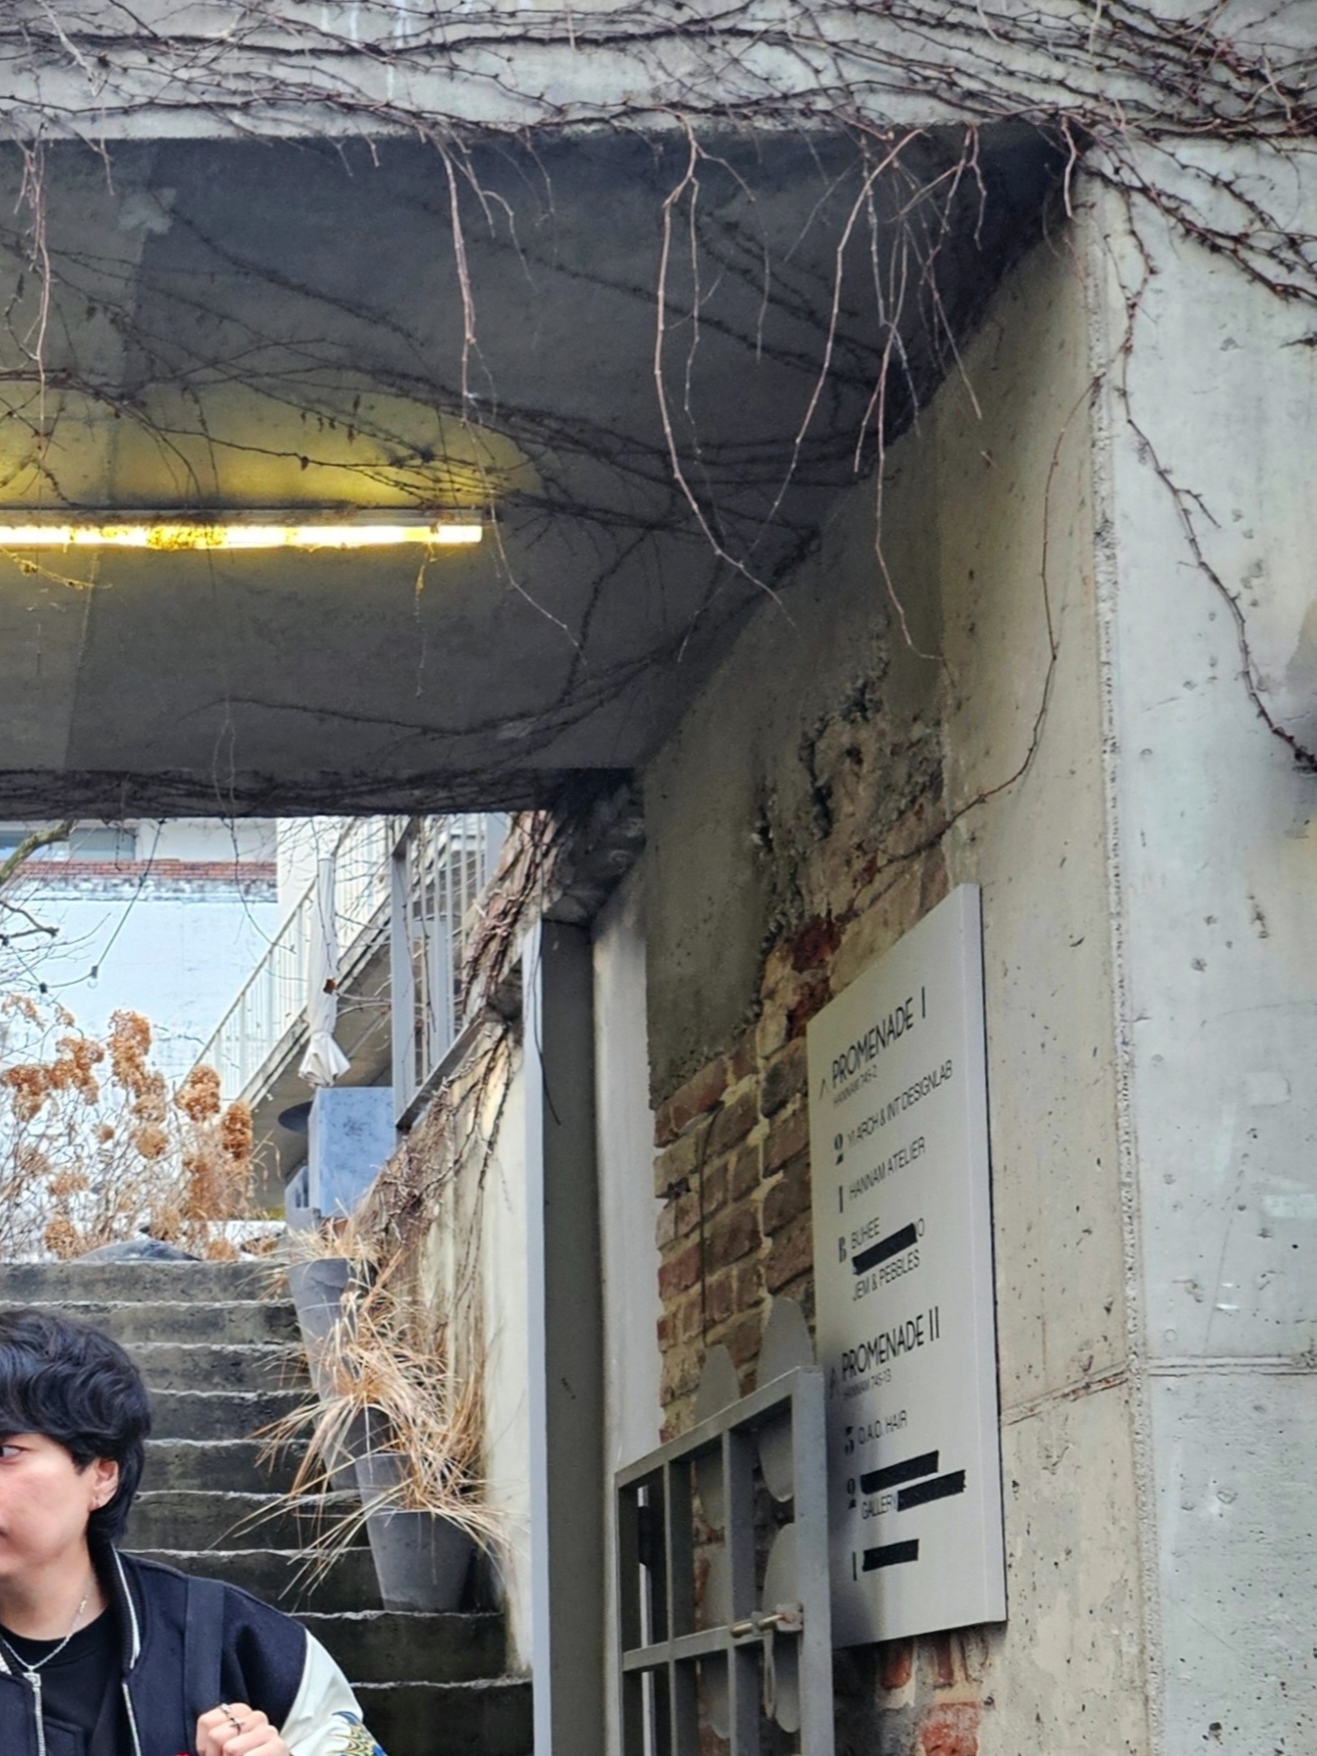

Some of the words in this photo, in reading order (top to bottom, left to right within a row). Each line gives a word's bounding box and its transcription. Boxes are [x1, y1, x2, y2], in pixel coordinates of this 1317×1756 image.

[832, 996, 914, 1090] PROMENADE
[849, 1162, 886, 1201] HANNAM
[887, 1136, 925, 1175] ATELIER
[879, 1249, 920, 1287] PEBBLES
[842, 1314, 924, 1382] PROMENADE
[885, 1410, 908, 1434] HAIR
